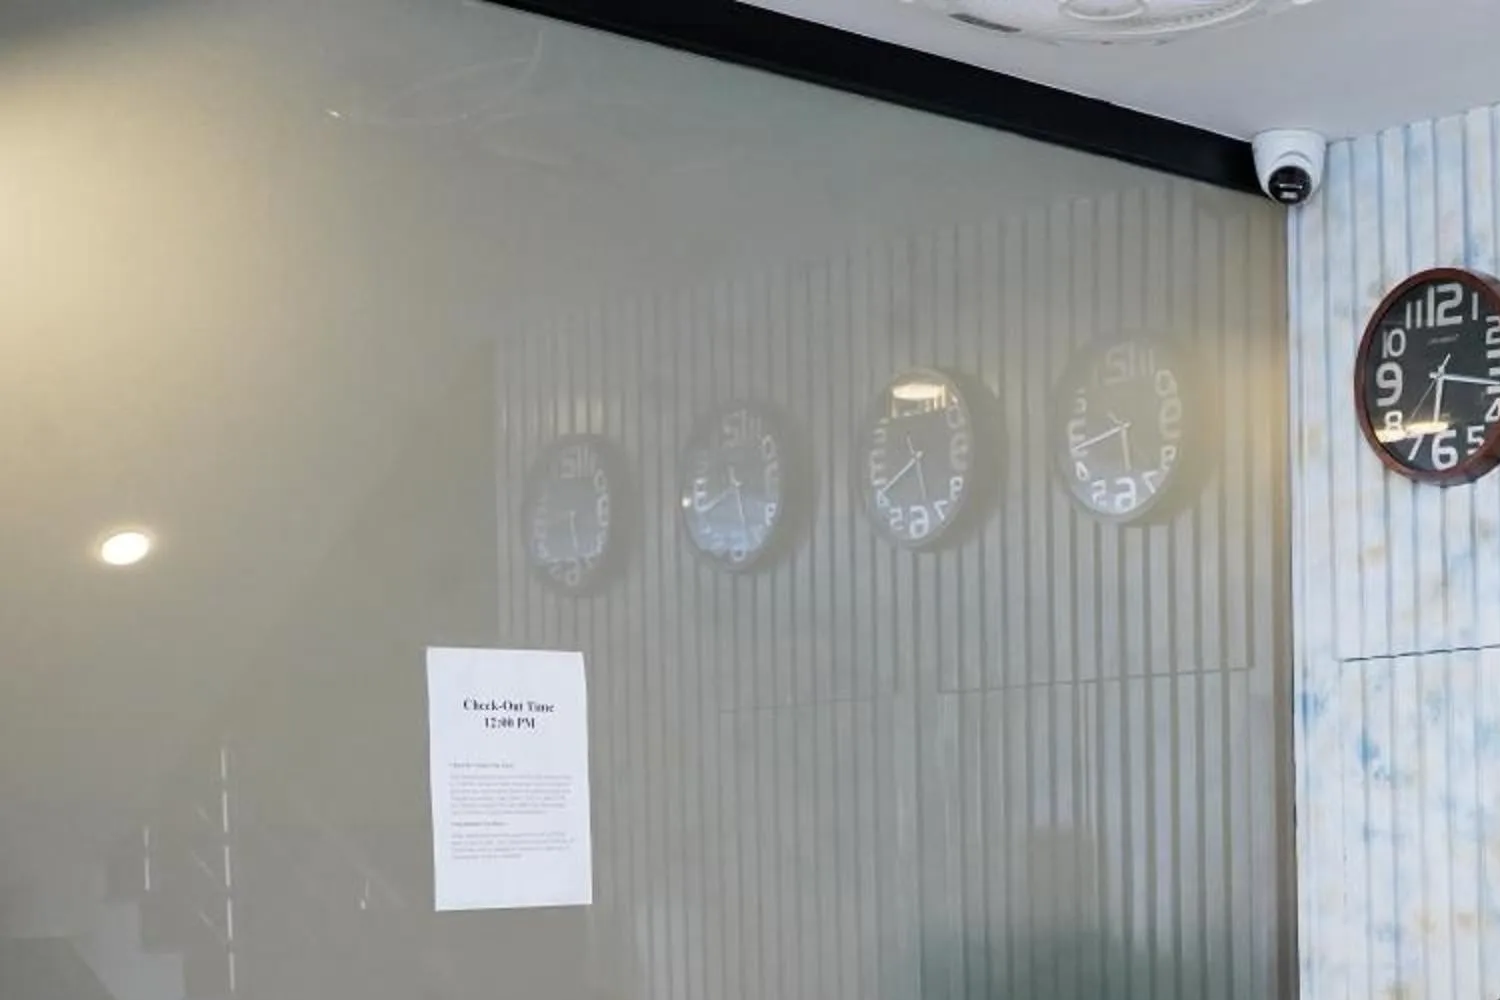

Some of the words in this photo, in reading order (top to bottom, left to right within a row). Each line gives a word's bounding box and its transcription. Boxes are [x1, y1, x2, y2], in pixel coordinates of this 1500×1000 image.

[1406, 299, 1422, 330] 11
[1427, 283, 1463, 327] 12
[1471, 292, 1478, 321] 1
[1382, 328, 1406, 358] 10
[1376, 362, 1403, 407] 9
[1432, 429, 1458, 470] 6
[1467, 425, 1485, 455] 5
[463, 699, 523, 712] Check-Out
[527, 701, 555, 713] Time
[517, 717, 535, 729] PM
